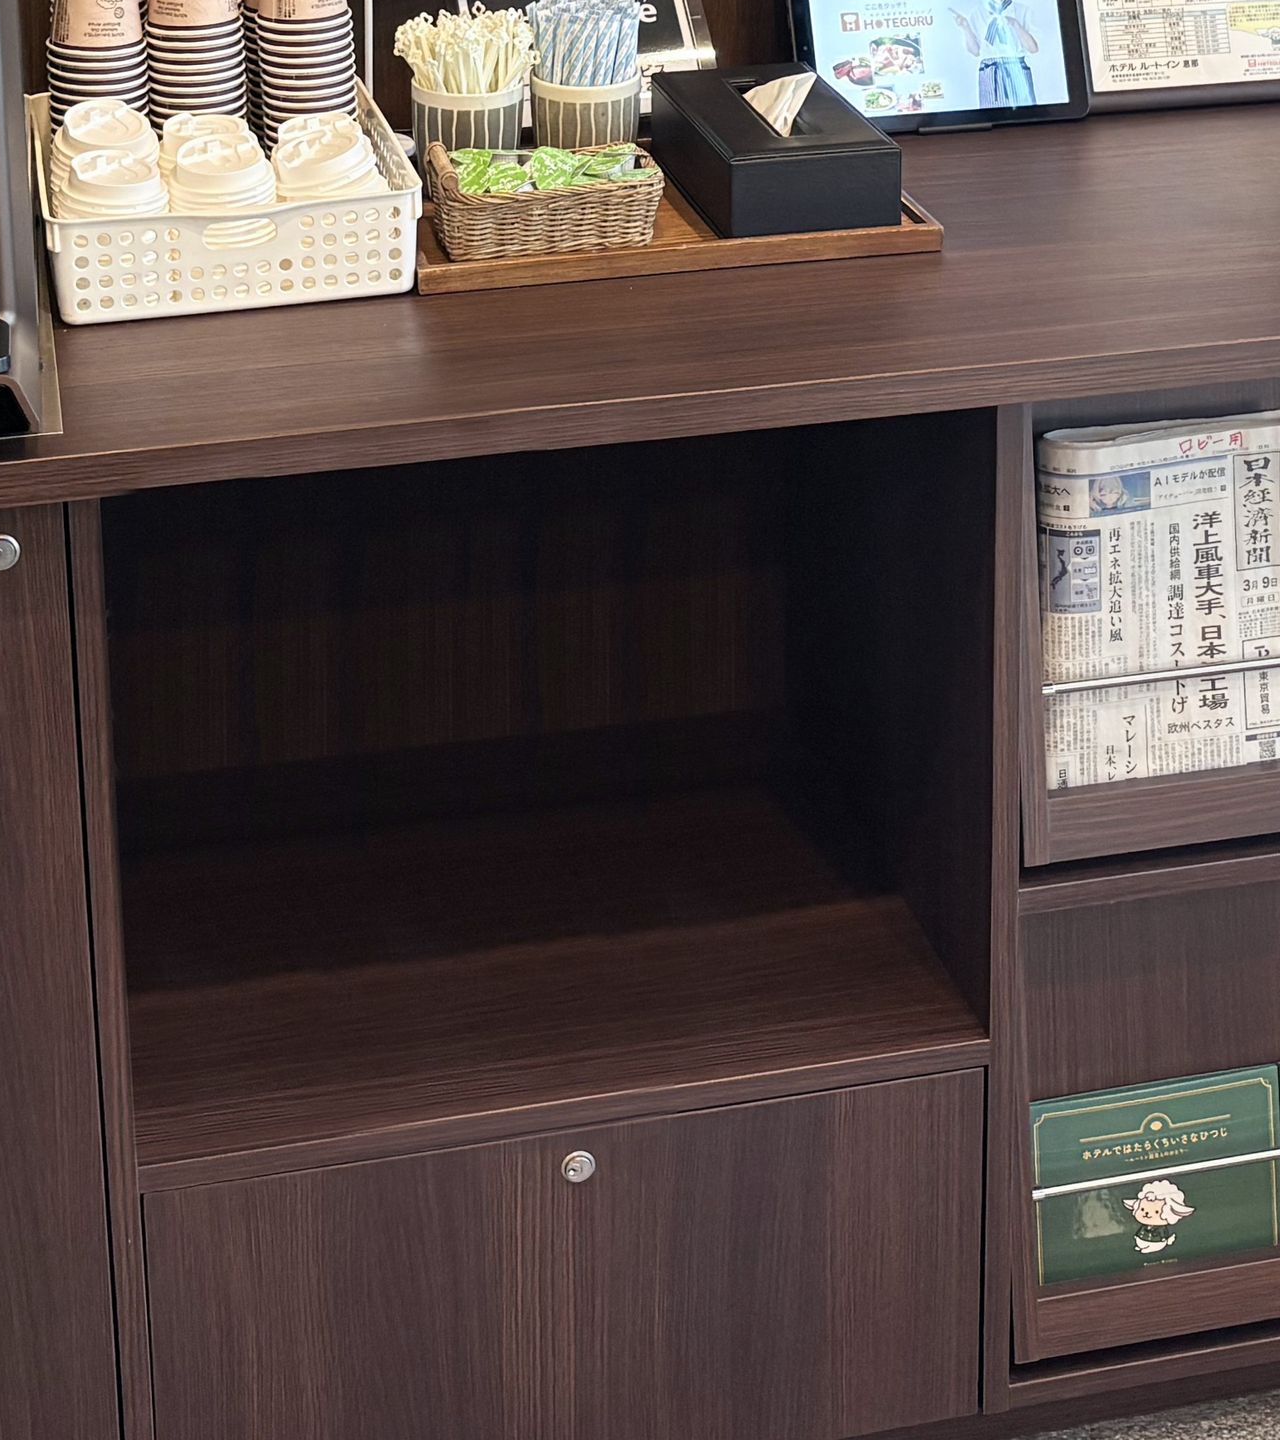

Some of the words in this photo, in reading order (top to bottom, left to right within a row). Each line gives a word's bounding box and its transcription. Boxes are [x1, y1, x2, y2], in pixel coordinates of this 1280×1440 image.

[863, 15, 934, 30] HOTEGURU
[1109, 63, 1137, 72] ホテル
[1140, 60, 1181, 71] ルートイン
[1178, 431, 1245, 454] ロビー用
[1153, 467, 1226, 488] AIモデルが配信
[1107, 527, 1124, 643] 再エネ拡大追い風
[1192, 511, 1231, 710] 洋上風車大手、日本工場
[1246, 594, 1276, 605] 月曜日
[1167, 716, 1236, 735] 欧州ベスタス
[1122, 714, 1138, 778] マレーシ
[1082, 1126, 1228, 1161] ホテルではたらくちいさなひつじ
